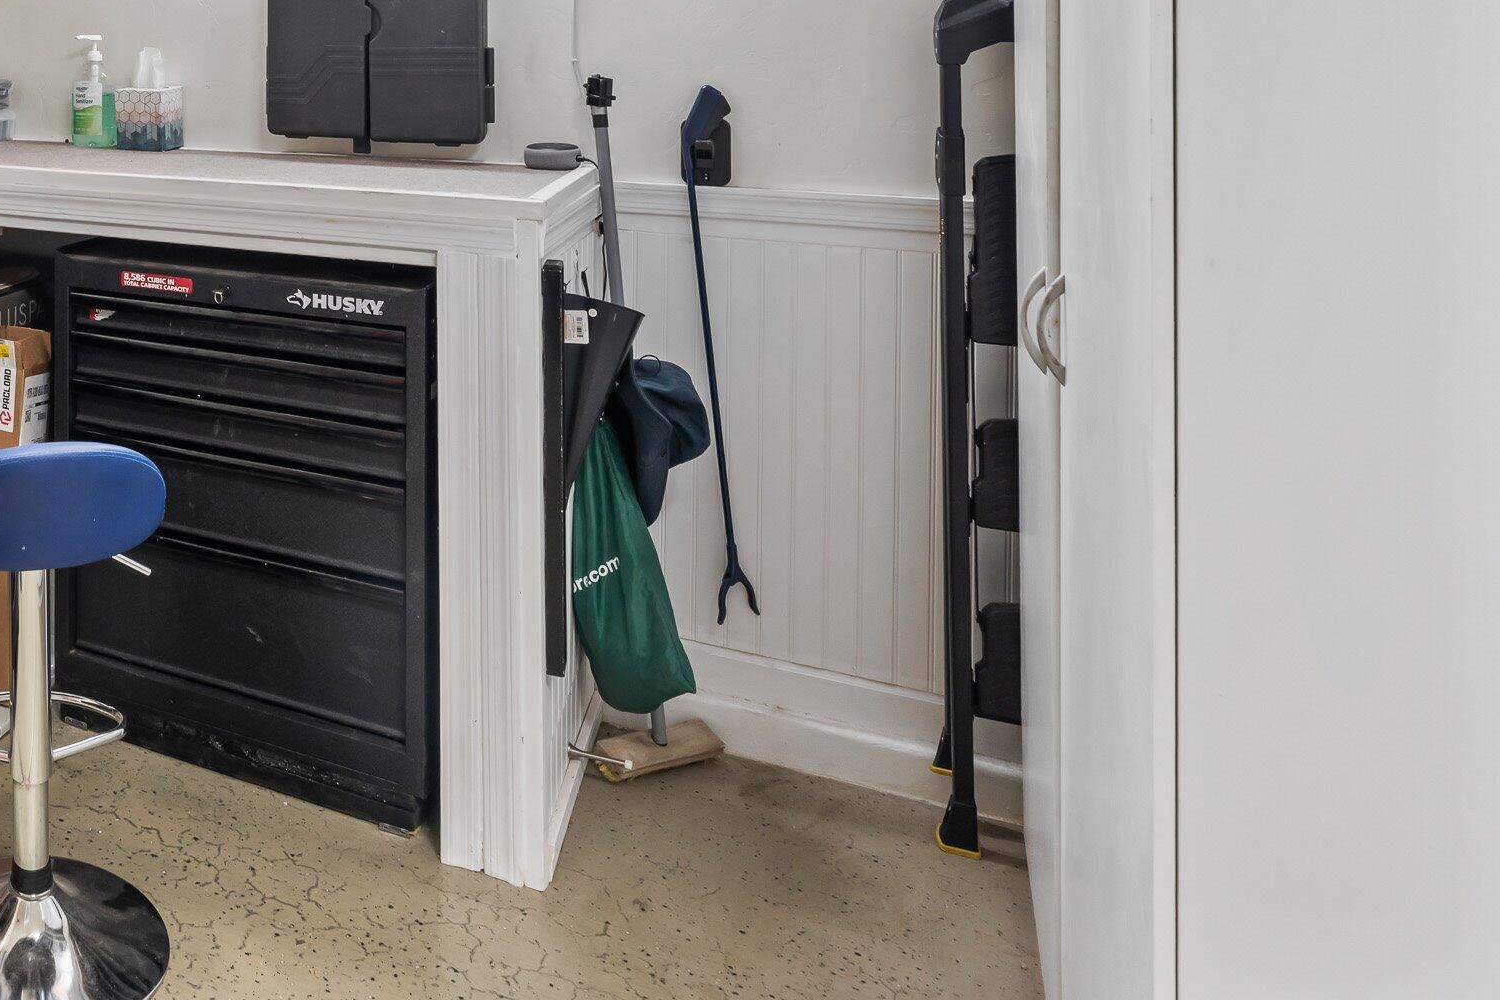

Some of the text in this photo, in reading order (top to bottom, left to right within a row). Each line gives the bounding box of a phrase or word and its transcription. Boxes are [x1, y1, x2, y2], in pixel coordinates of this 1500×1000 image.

[123, 272, 146, 283] 8,586
[147, 276, 166, 285] CUBIC
[140, 282, 163, 290] CABINET
[163, 284, 190, 293] CAPACITY
[311, 292, 384, 316] HUSKY
[2, 368, 12, 410] PACLORD
